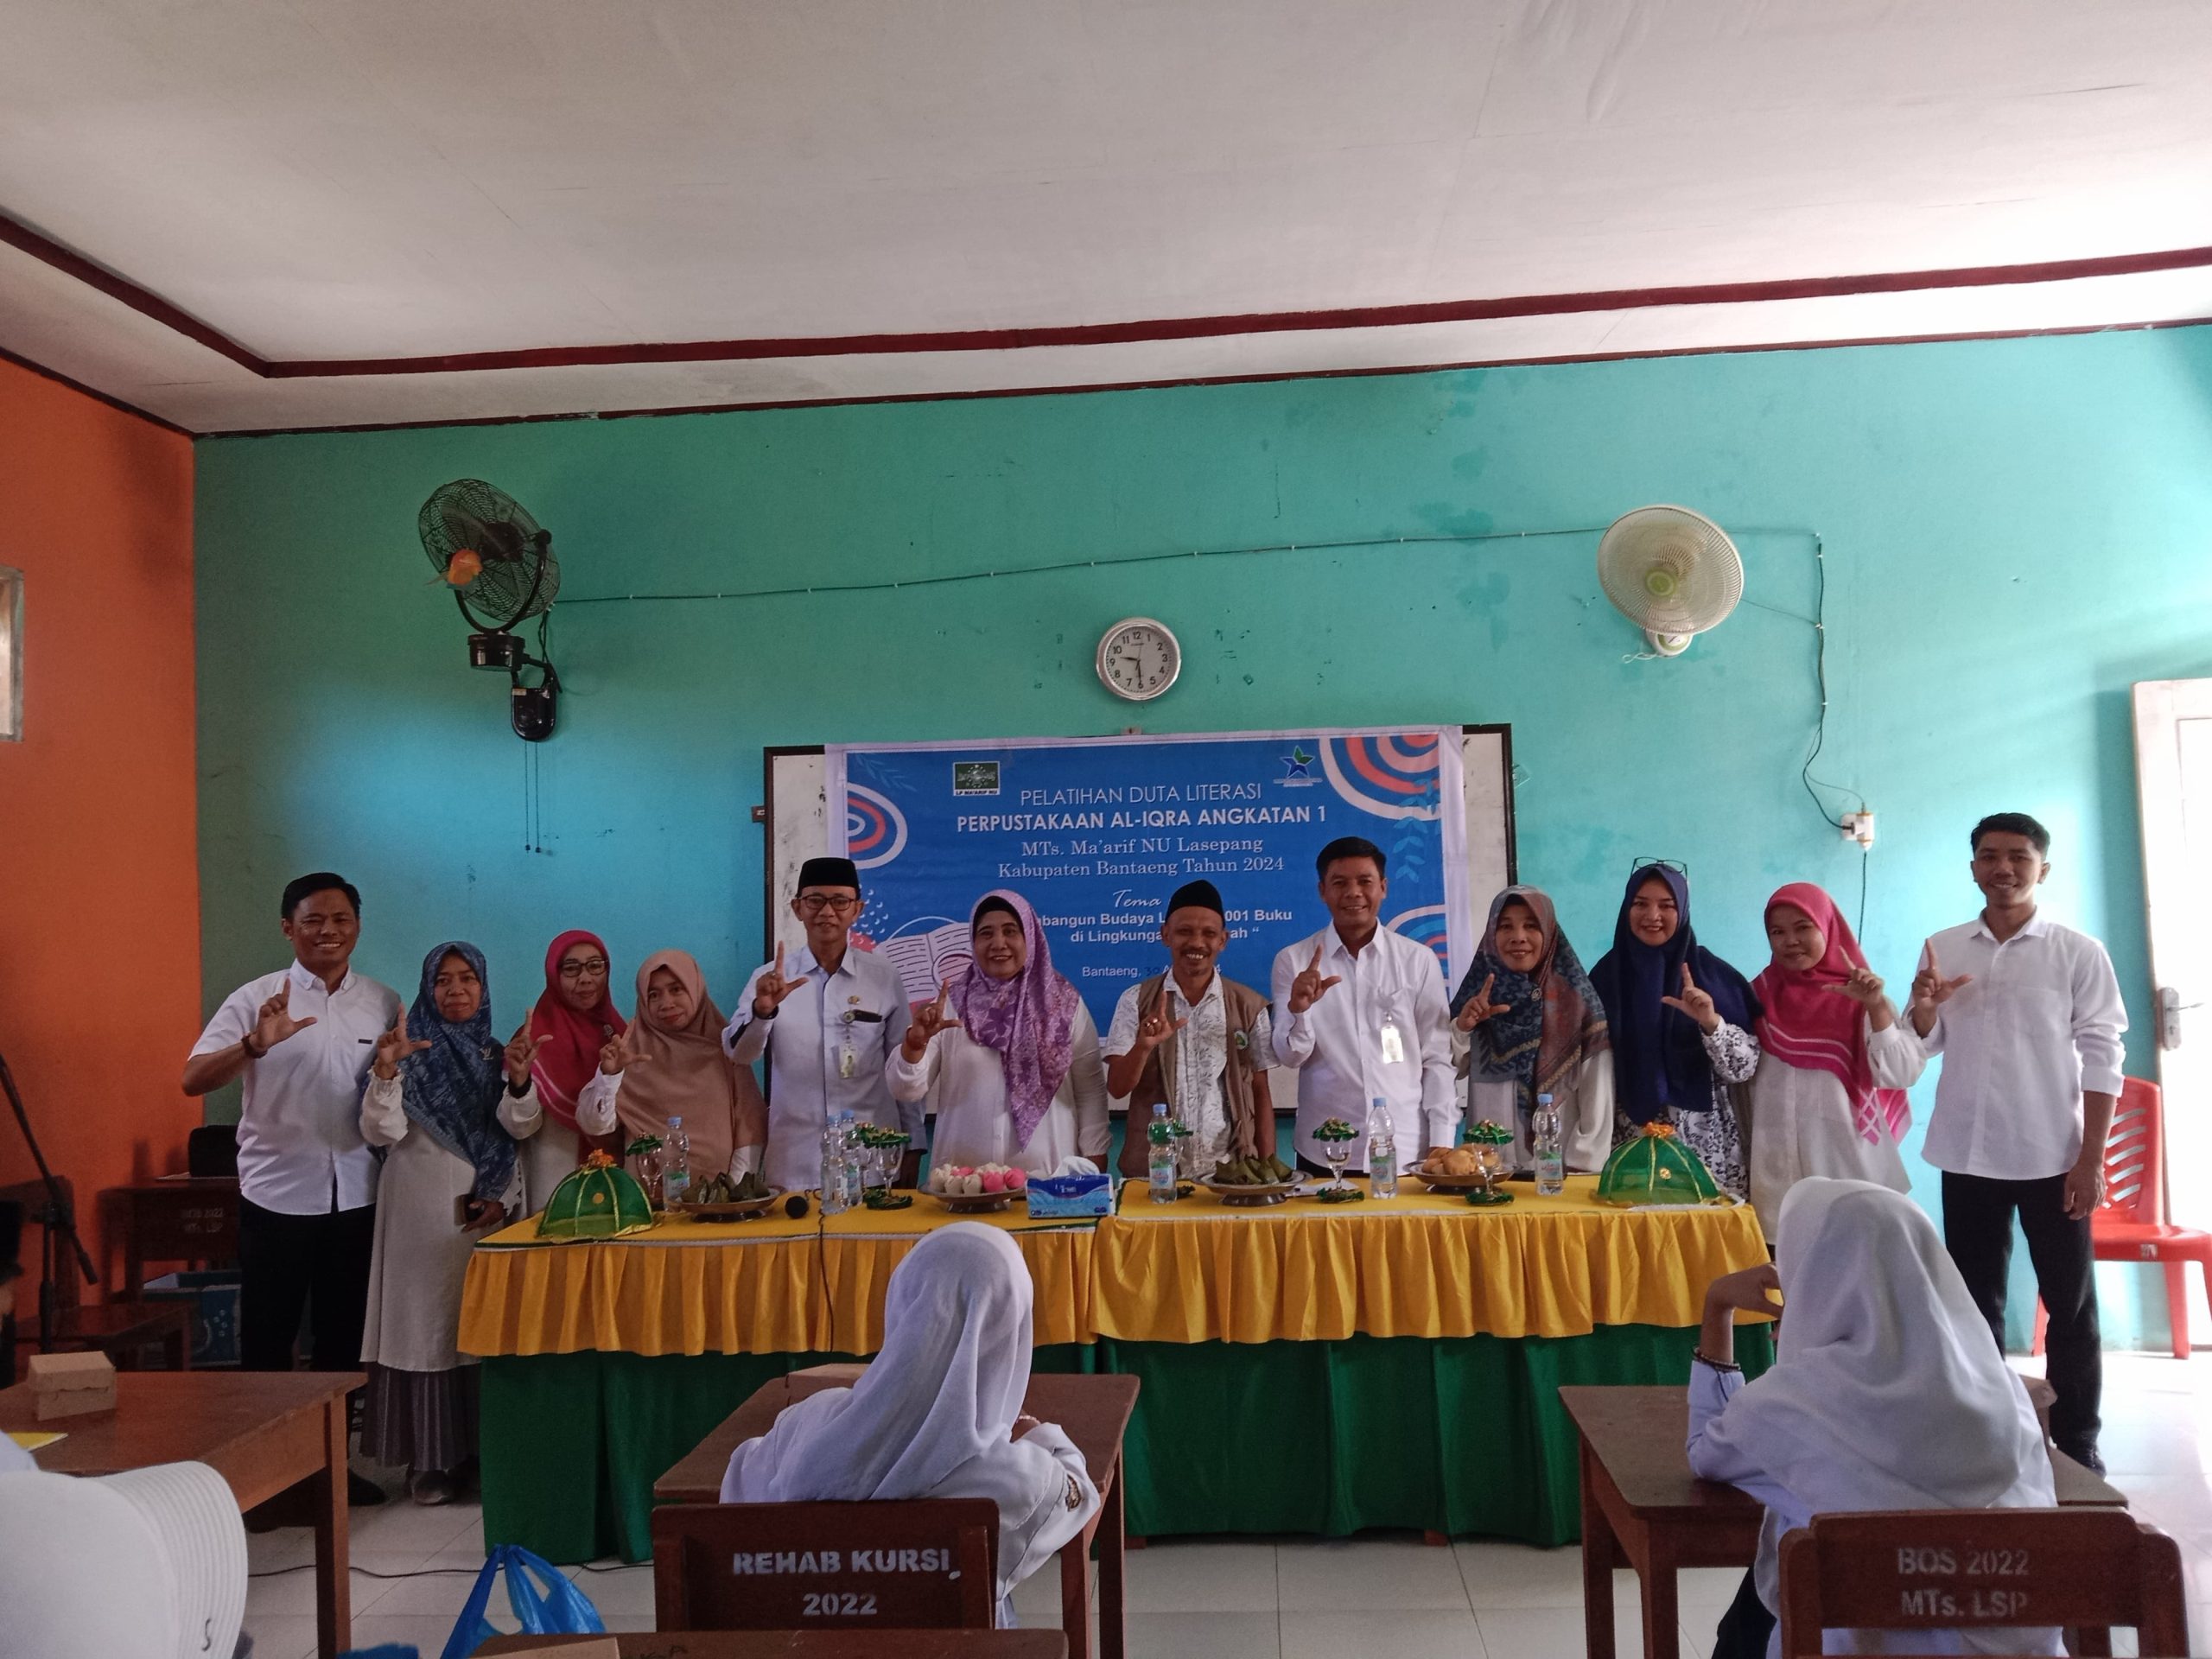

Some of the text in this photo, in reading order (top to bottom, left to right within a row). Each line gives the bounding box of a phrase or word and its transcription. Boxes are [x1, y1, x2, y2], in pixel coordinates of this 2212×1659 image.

[1113, 645, 1122, 654] 10
[1109, 658, 1116, 666] 9
[1115, 670, 1121, 678] 8
[1020, 787, 1122, 806] PELATIHAN
[1129, 785, 1180, 803] DUTA
[1186, 783, 1262, 802] LITERASI
[957, 805, 1325, 832] PERPUSTAKAAN AL-IQRA ANGKATAN 1
[1021, 841, 1065, 856] MTs.
[1141, 837, 1172, 853] NU
[1178, 836, 1263, 855] Lasepang
[998, 856, 1284, 880] Kabupaten Bantaeng Tahun 2024
[1112, 889, 1162, 907] Tema
[1100, 912, 1154, 926] Budaya
[1224, 909, 1293, 922] 001 Buku
[1071, 930, 1162, 944] di Lingkunga
[733, 1551, 841, 1575] REHAB
[1897, 1547, 2031, 1576] BOS 2022
[802, 1592, 878, 1617] 2022
[1900, 1588, 2029, 1618] MTs. LSP
